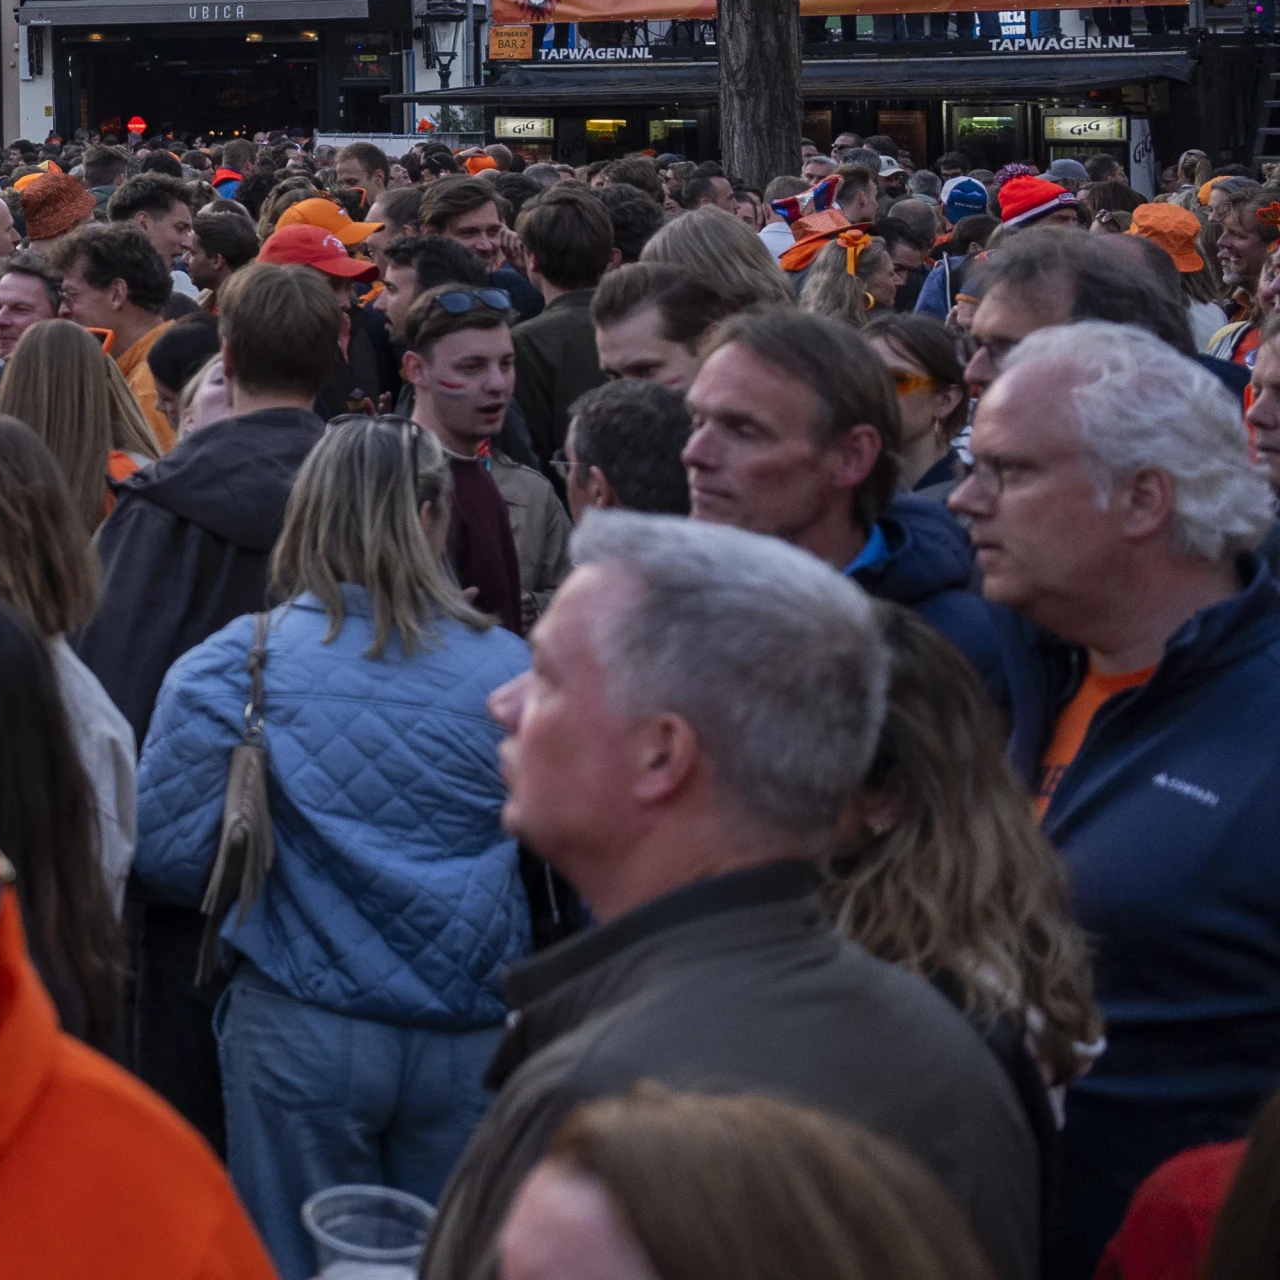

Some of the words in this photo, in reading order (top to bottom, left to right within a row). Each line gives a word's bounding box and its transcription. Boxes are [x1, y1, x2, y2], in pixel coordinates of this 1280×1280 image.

[190, 5, 245, 19] UBICA
[498, 39, 518, 49] BAR
[519, 39, 526, 49] 2
[989, 35, 1135, 51] TAPWAGEN.NL
[539, 47, 653, 60] TAPWAGEN.NL
